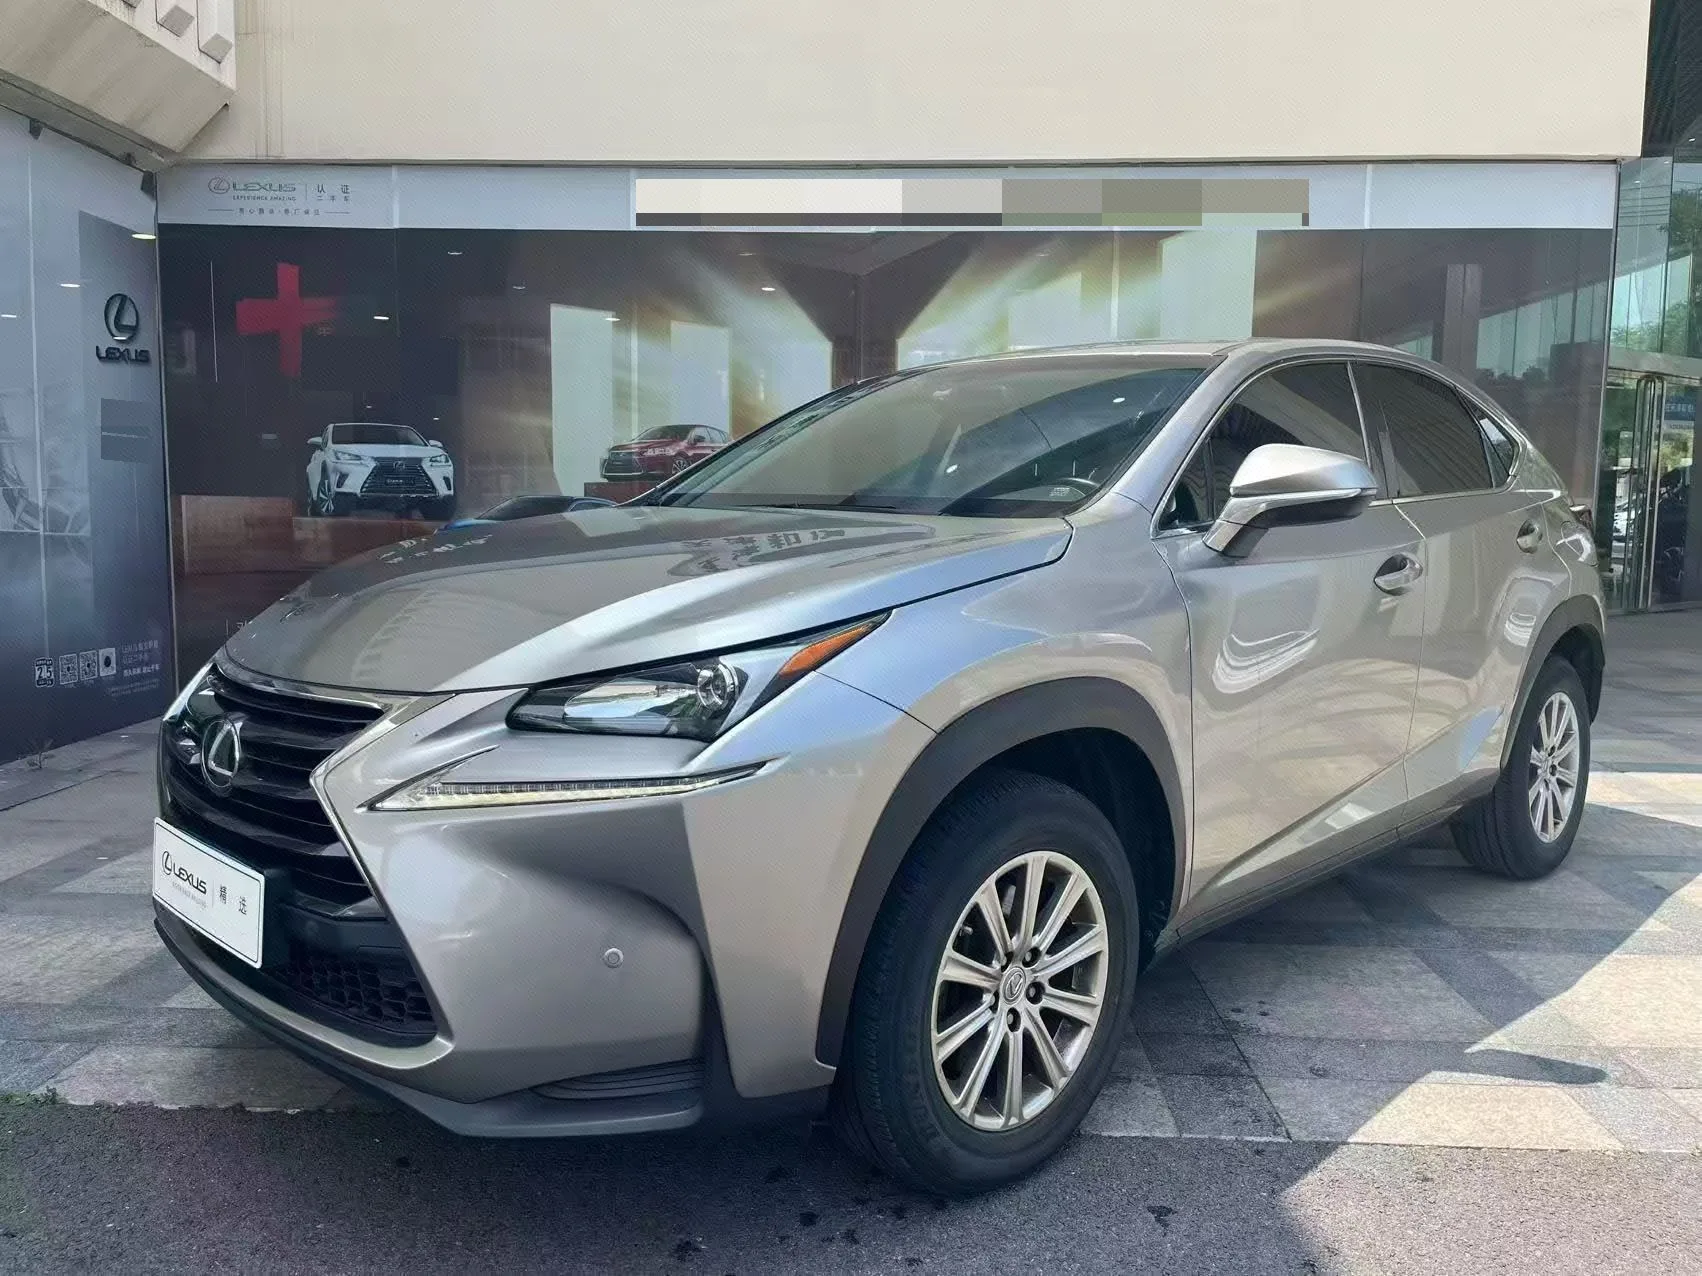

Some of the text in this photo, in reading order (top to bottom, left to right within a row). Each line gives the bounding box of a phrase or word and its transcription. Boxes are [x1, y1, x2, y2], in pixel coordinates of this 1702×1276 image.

[232, 181, 297, 193] LEXUS
[95, 345, 151, 364] LEXUS
[172, 862, 207, 895] LEXUS
